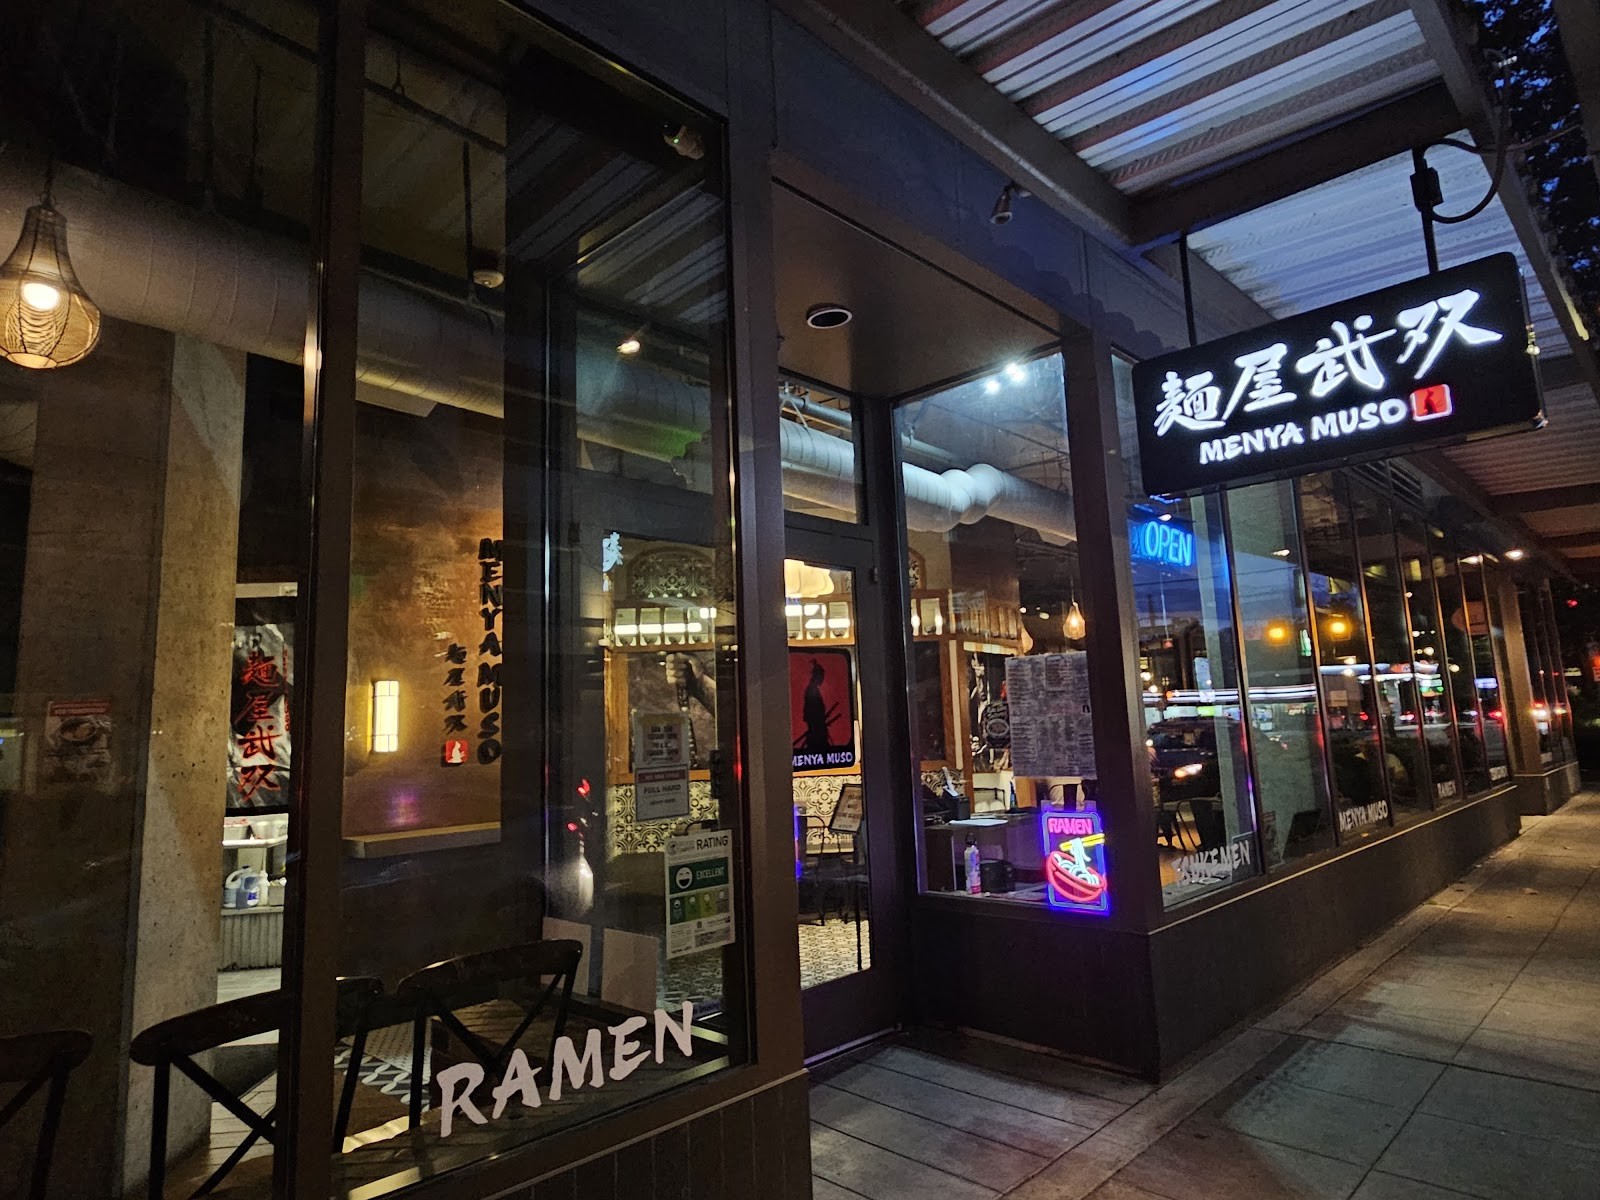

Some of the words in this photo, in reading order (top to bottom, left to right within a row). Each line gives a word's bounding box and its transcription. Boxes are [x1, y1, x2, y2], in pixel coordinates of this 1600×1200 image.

[1199, 421, 1305, 465] MENYA
[1311, 398, 1408, 441] MUSO
[1144, 520, 1192, 567] OPEN
[478, 537, 503, 657] MENYA
[476, 662, 502, 766] MUSO
[826, 751, 853, 764] MUSO
[1047, 817, 1093, 835] RAMEN
[1339, 805, 1367, 832] MENYA
[696, 835, 729, 850] RATING
[696, 866, 725, 880] EXCELLENT
[436, 1000, 694, 1138] RAMEN
